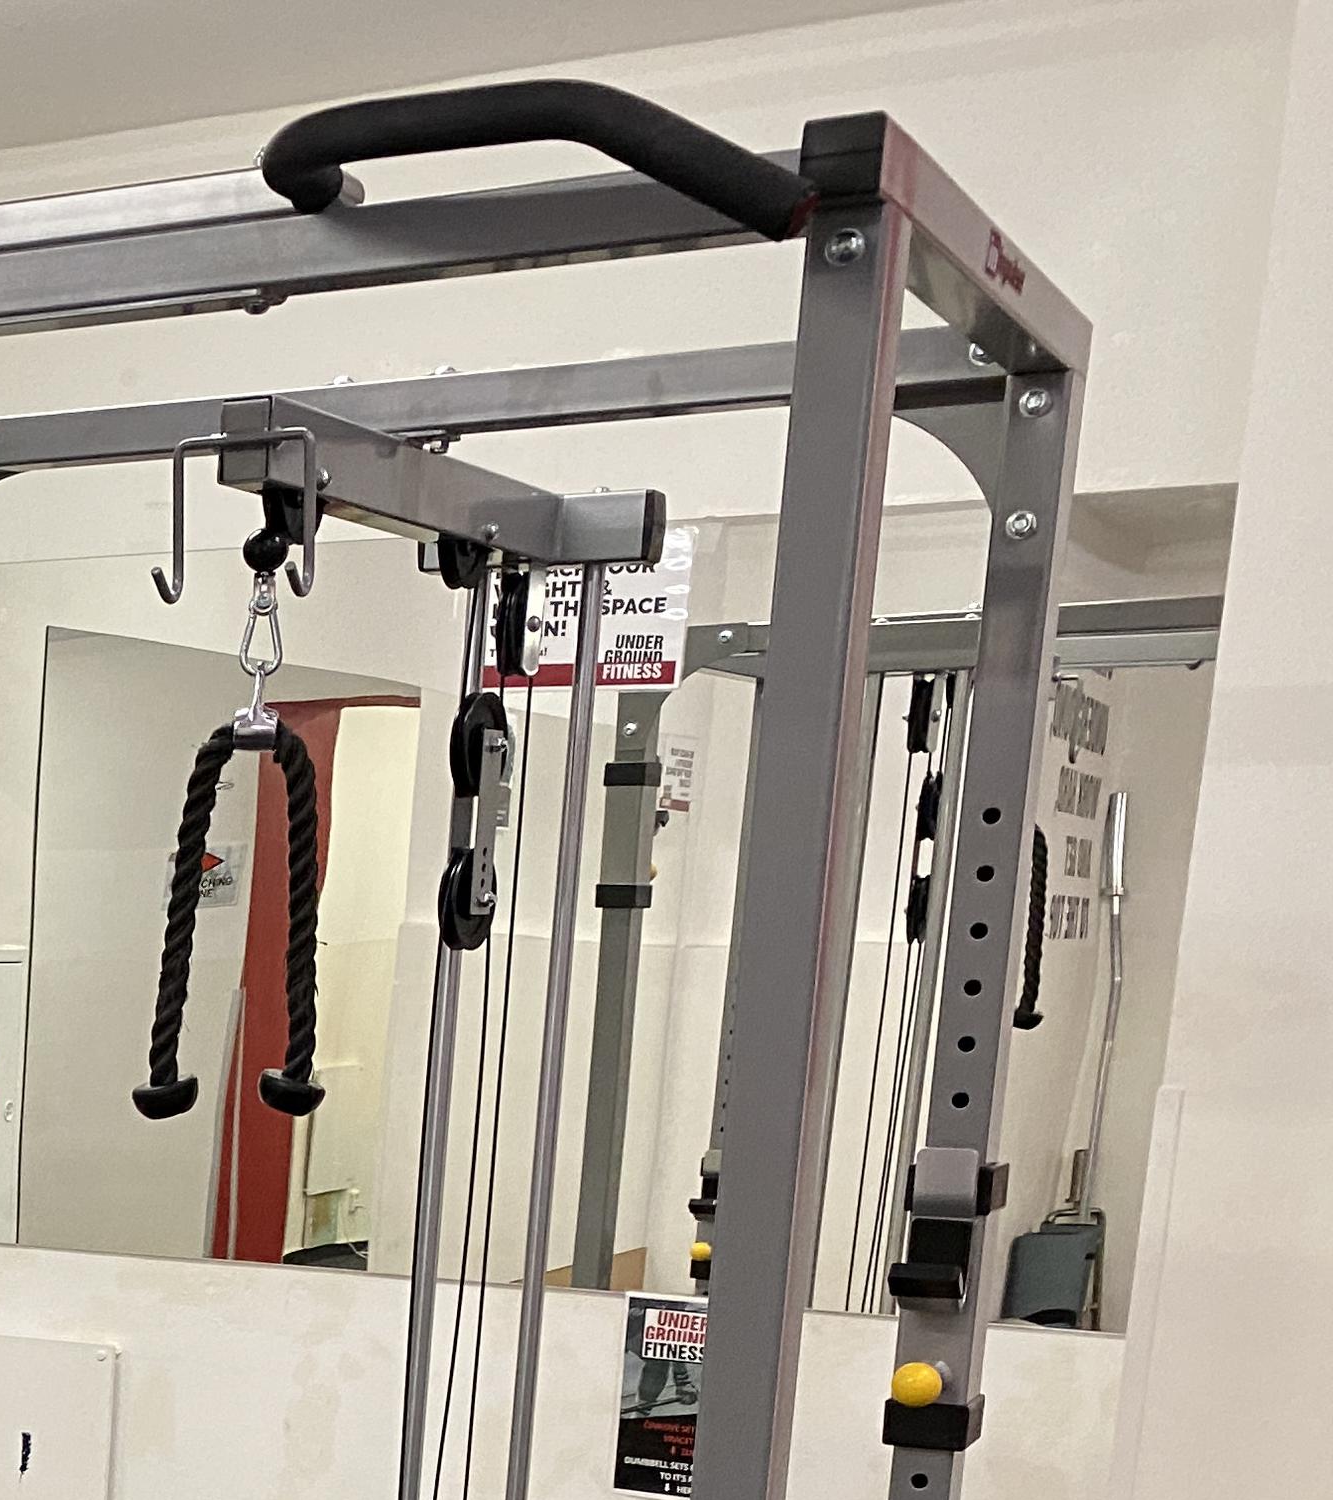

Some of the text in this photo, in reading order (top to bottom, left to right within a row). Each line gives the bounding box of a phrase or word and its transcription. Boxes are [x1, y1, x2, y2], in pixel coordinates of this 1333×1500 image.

[550, 597, 667, 617] TH SPACE
[615, 634, 664, 650] UNDER
[604, 650, 663, 663] GROUND
[602, 663, 662, 680] FITNESS
[660, 1472, 671, 1480] TO
